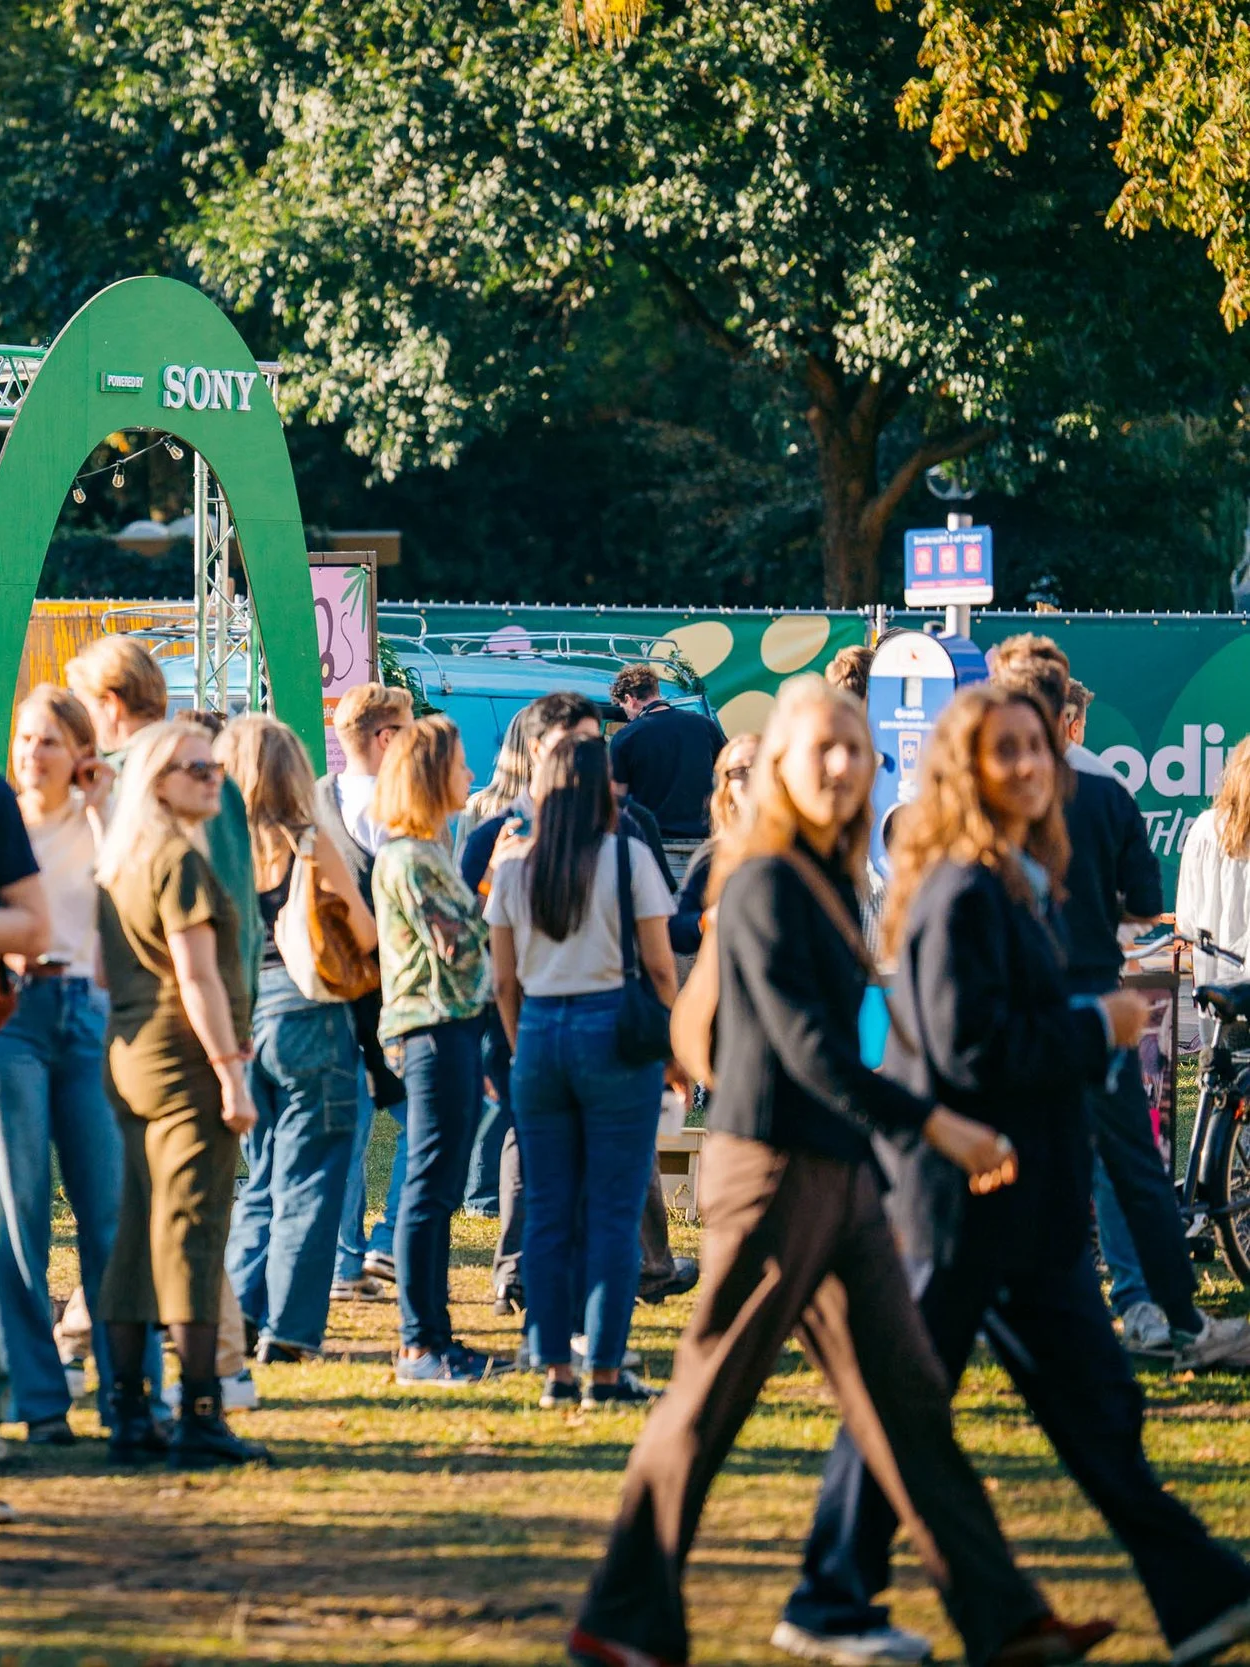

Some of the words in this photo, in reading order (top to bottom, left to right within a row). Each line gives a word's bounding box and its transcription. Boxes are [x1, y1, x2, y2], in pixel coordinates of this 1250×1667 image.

[107, 374, 136, 388] POWERED
[135, 376, 144, 388] BY
[163, 364, 257, 411] SONY
[1098, 723, 1237, 797] odi
